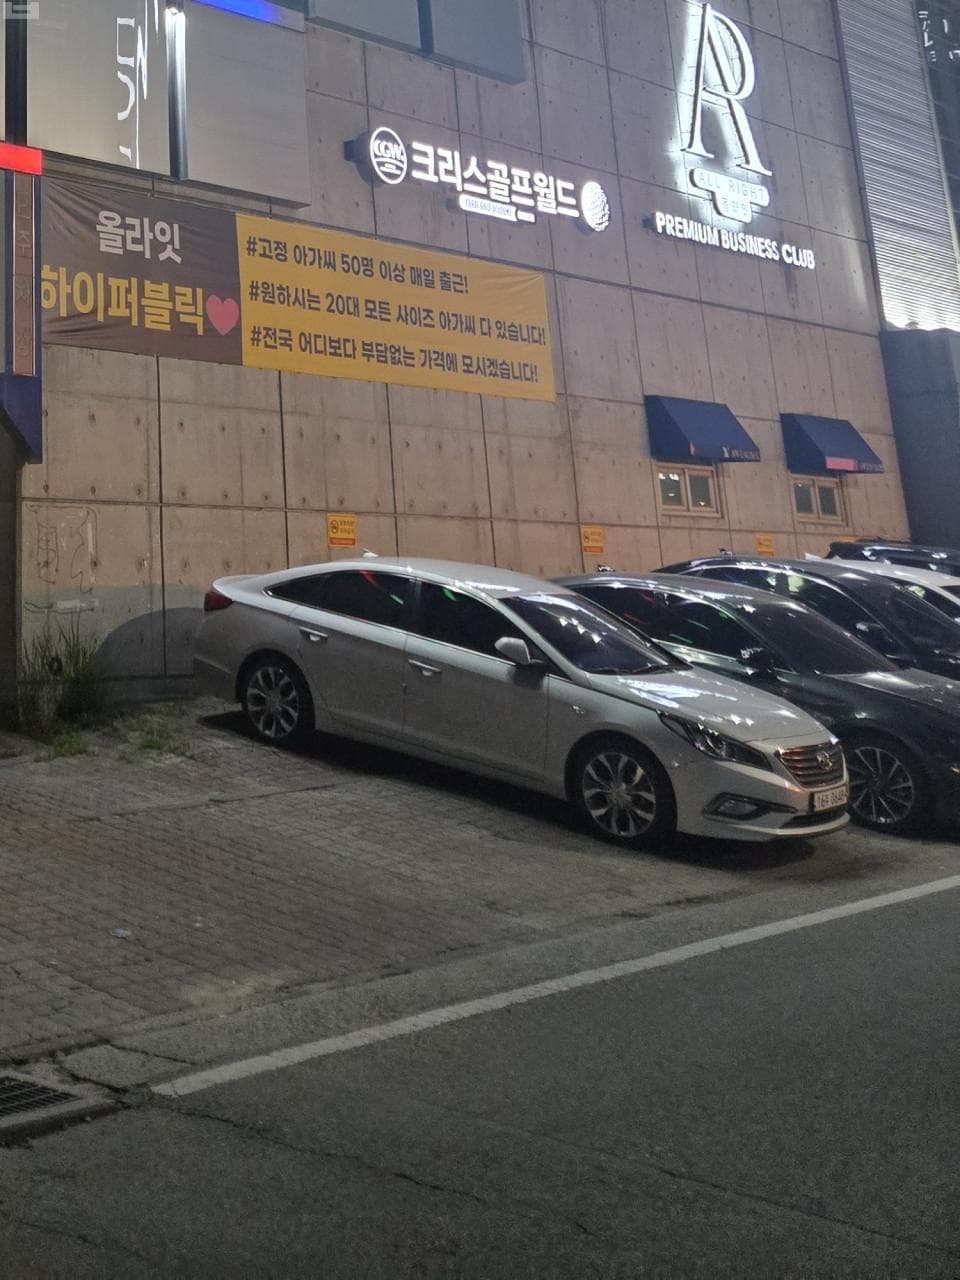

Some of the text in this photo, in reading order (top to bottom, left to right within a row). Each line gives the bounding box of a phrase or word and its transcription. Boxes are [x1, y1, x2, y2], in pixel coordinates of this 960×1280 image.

[412, 141, 580, 218] 크리스골프월드
[96, 210, 182, 264] 올라잇
[246, 236, 469, 294] #고정 아가씨 50명 이상 매일 출근!
[655, 211, 816, 270] PREMIUM BUSINESS CLUB
[41, 264, 204, 336] 하이퍼블릭
[248, 279, 546, 346] #원하시는 20대 모든 사이즈 아가씨 다 있습니다!
[250, 325, 538, 383] #전국 어디보다 부담없는 가격에 모시겠습니다!
